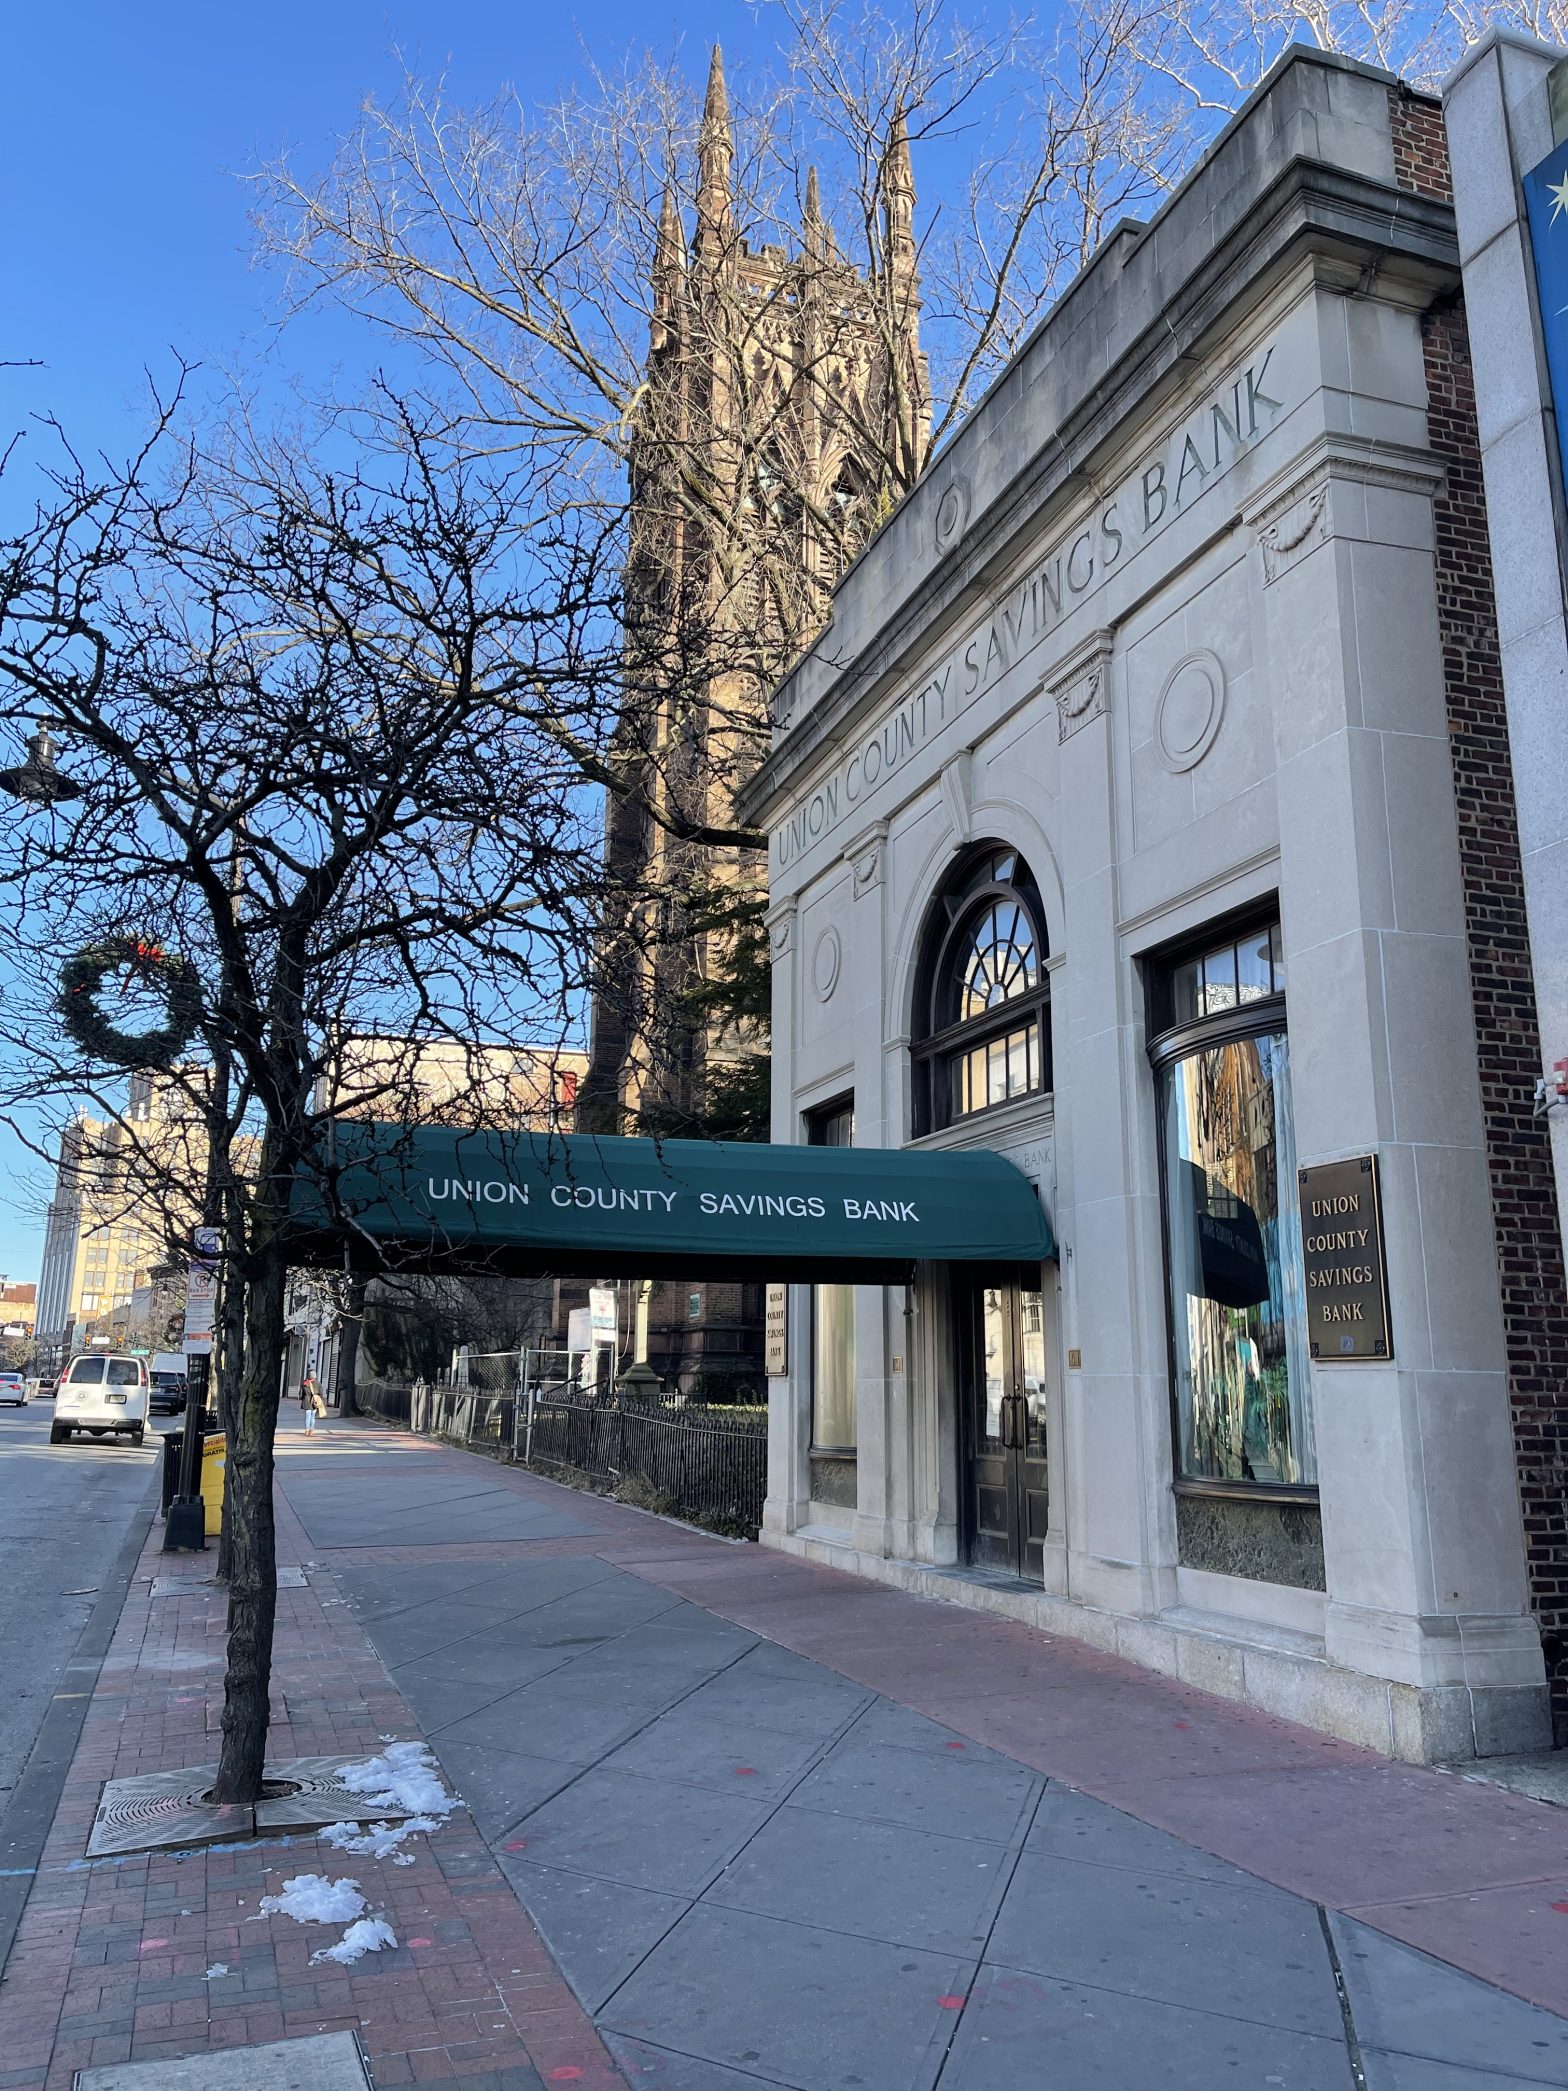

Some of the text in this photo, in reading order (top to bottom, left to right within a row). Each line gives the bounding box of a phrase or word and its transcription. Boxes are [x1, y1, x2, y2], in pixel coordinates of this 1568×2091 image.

[778, 344, 1285, 865] UNION COUNTY SAVINGS BANK
[1024, 1147, 1051, 1168] BANK
[429, 1178, 920, 1222] UNION COUNTY SAVINGS BANK
[1312, 1194, 1359, 1217] UNION
[1307, 1229, 1368, 1252] COUNTY
[1309, 1266, 1373, 1287] SAVINGS
[1322, 1303, 1364, 1322] BANK
[203, 1449, 224, 1457] GRATIS
